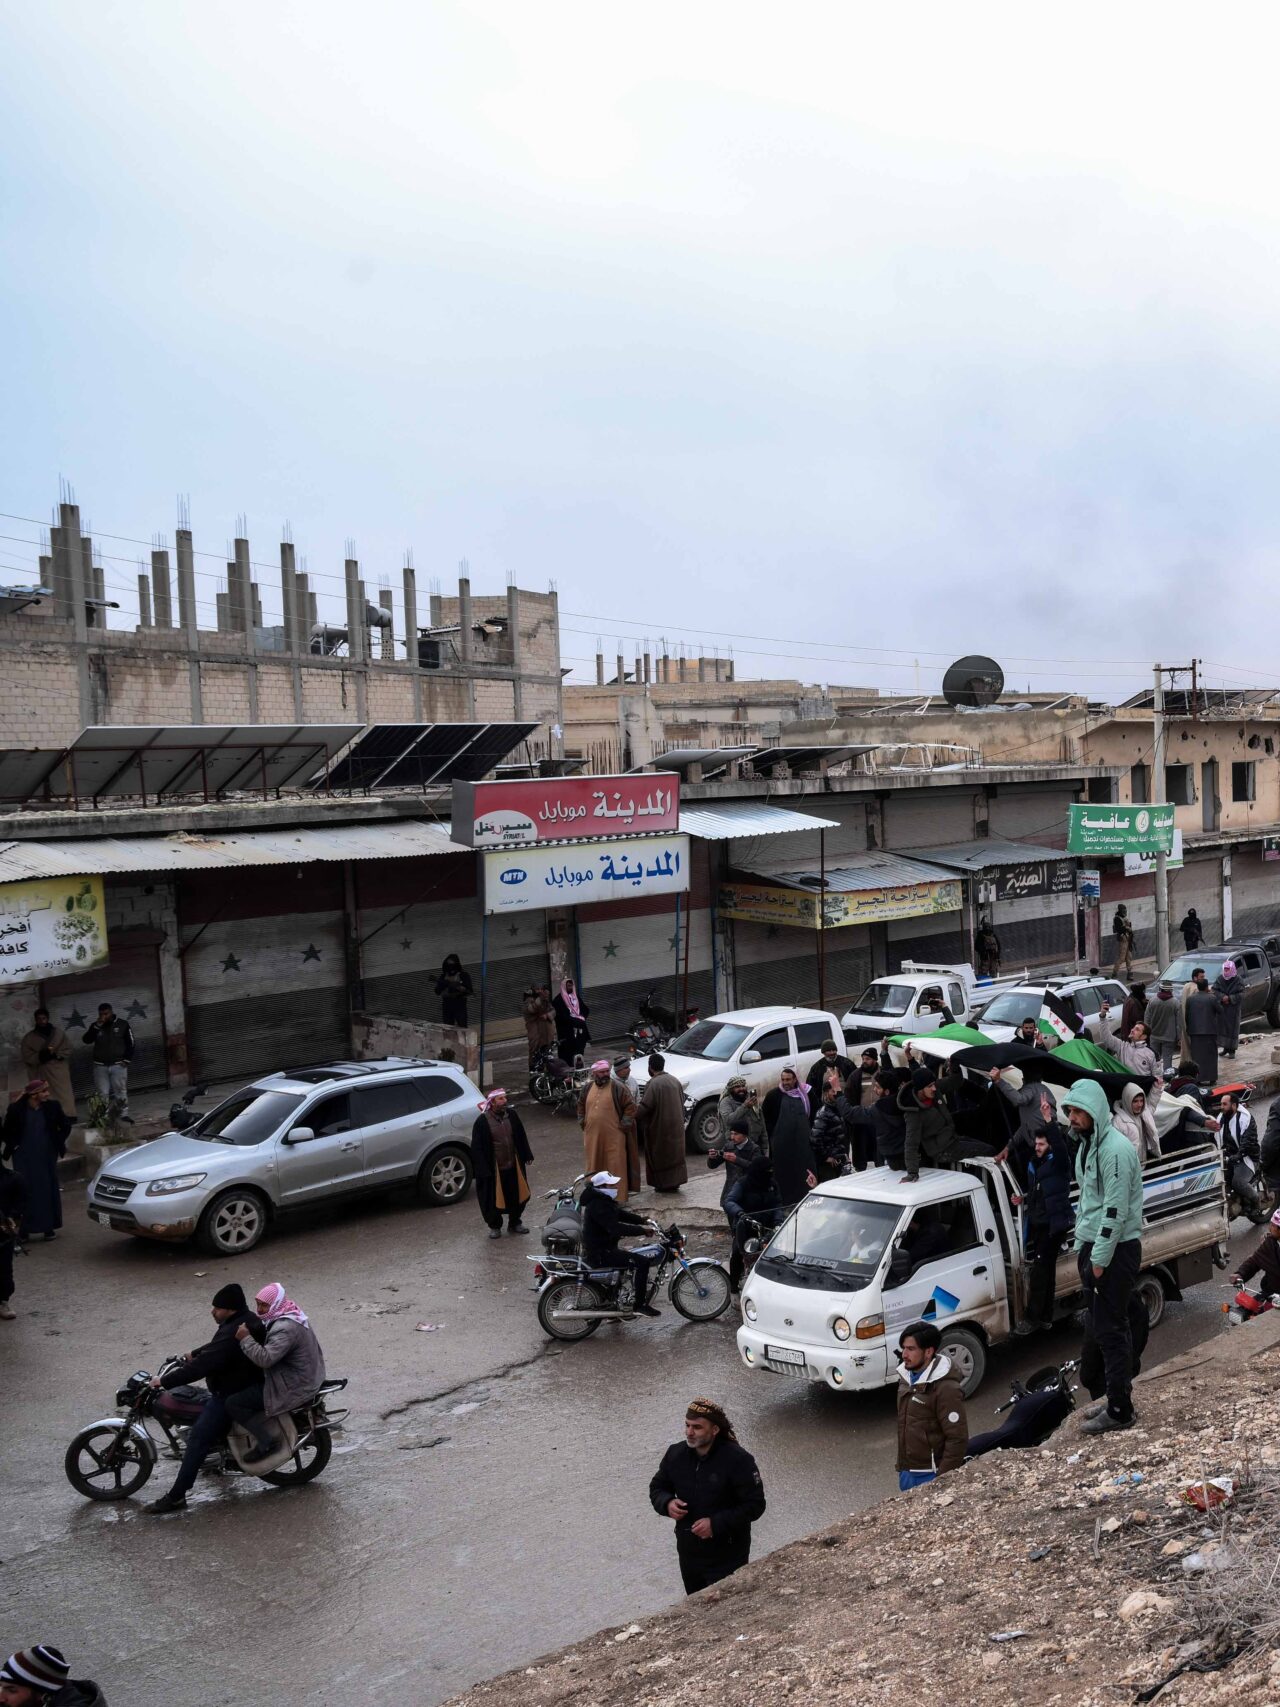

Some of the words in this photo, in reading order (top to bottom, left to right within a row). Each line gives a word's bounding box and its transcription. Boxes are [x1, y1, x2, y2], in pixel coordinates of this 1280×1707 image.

[538, 800, 587, 823] موبايل
[593, 788, 671, 825] المدينة
[1081, 811, 1130, 831] عافية
[1153, 813, 1174, 831] صيدلية
[503, 871, 525, 881] MTN
[545, 866, 593, 889] موبايل
[600, 850, 680, 886] المدينة
[855, 888, 888, 910] الجسر
[891, 887, 931, 903] استراحة
[801, 1196, 825, 1209] 2002
[796, 1255, 838, 1270] HYUNDAI
